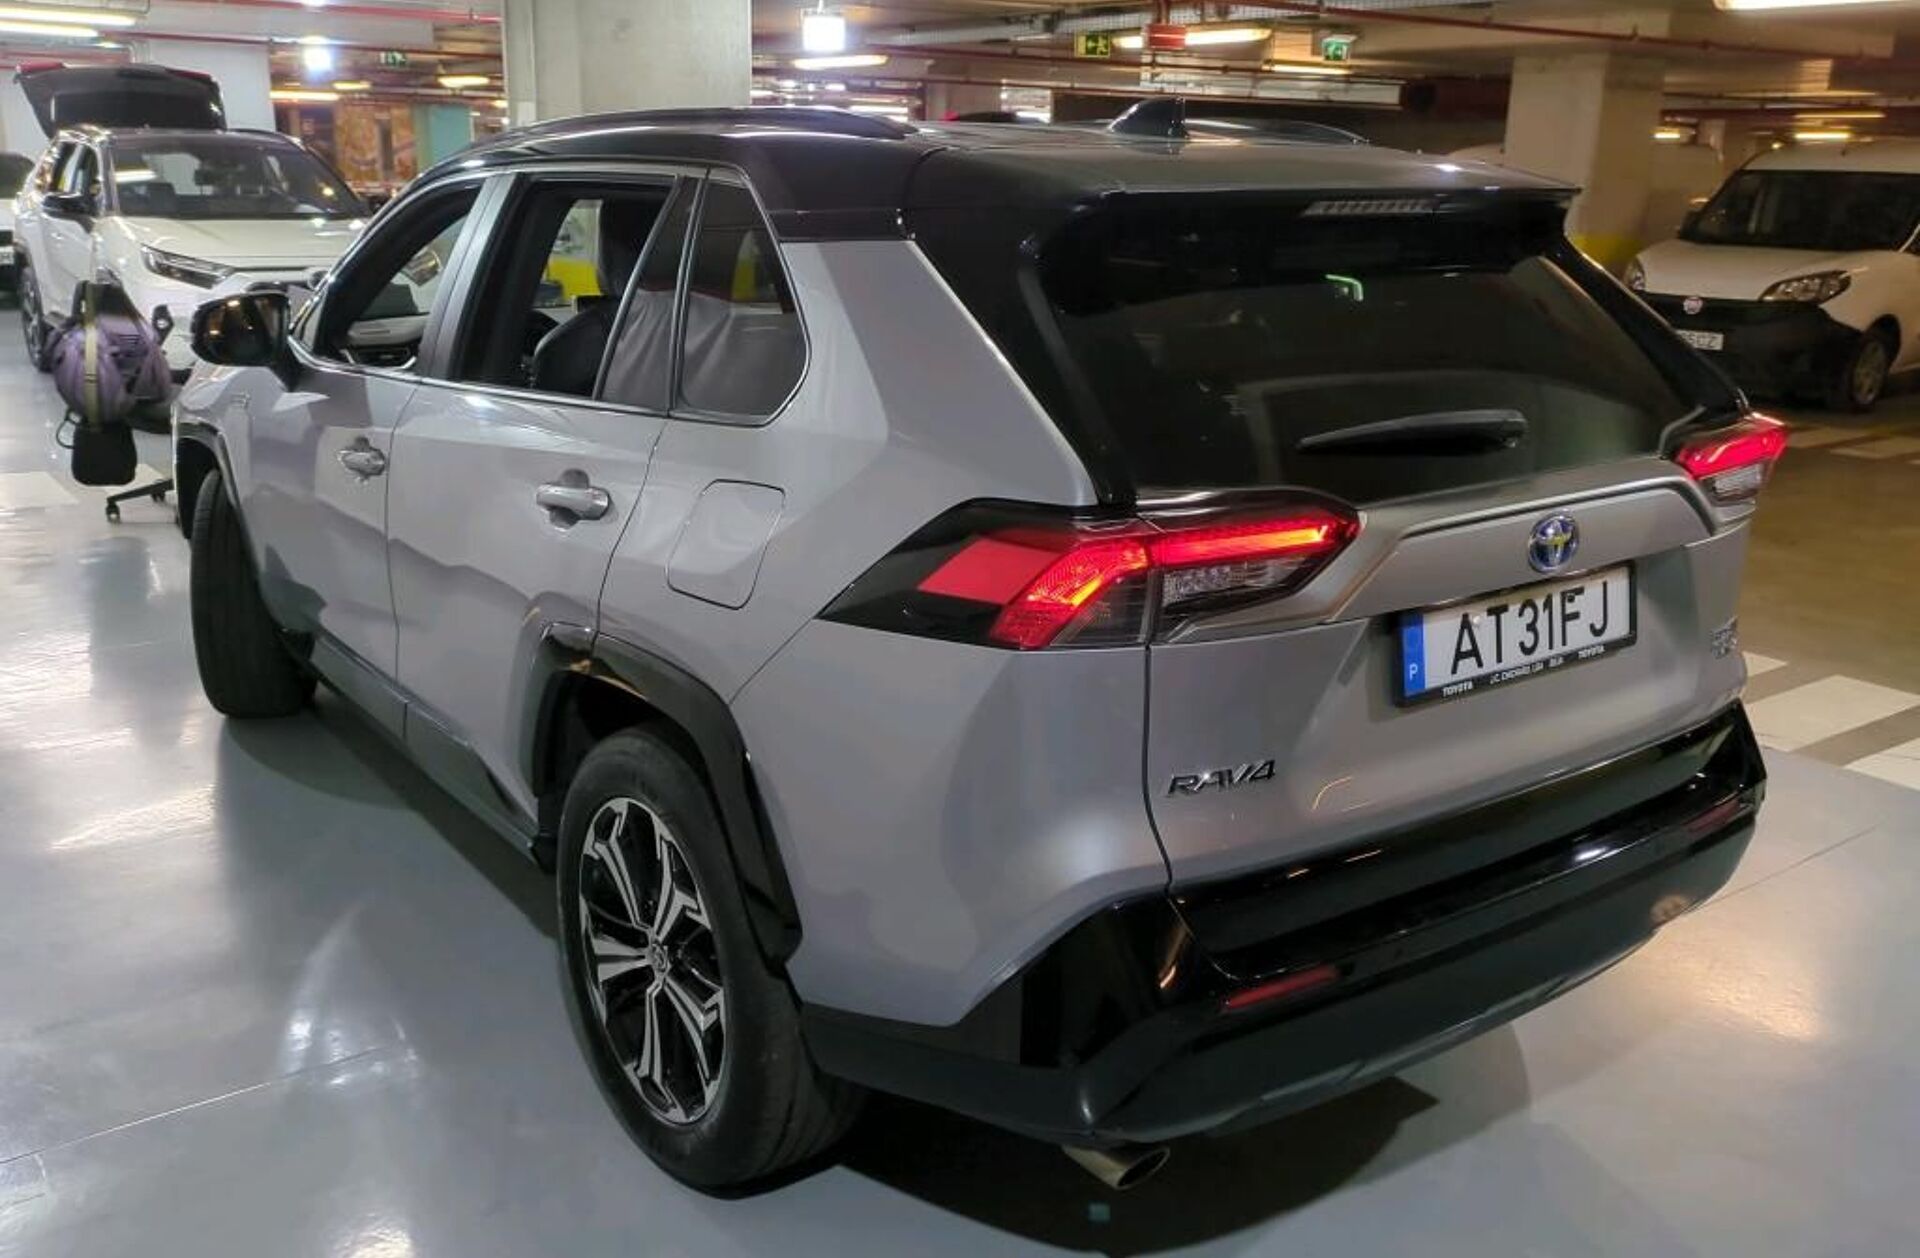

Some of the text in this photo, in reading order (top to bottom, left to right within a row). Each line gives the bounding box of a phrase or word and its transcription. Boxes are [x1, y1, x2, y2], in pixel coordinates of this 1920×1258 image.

[1451, 581, 1609, 675] AT31FJ
[1409, 664, 1419, 681] P
[1167, 760, 1275, 794] RAV4
